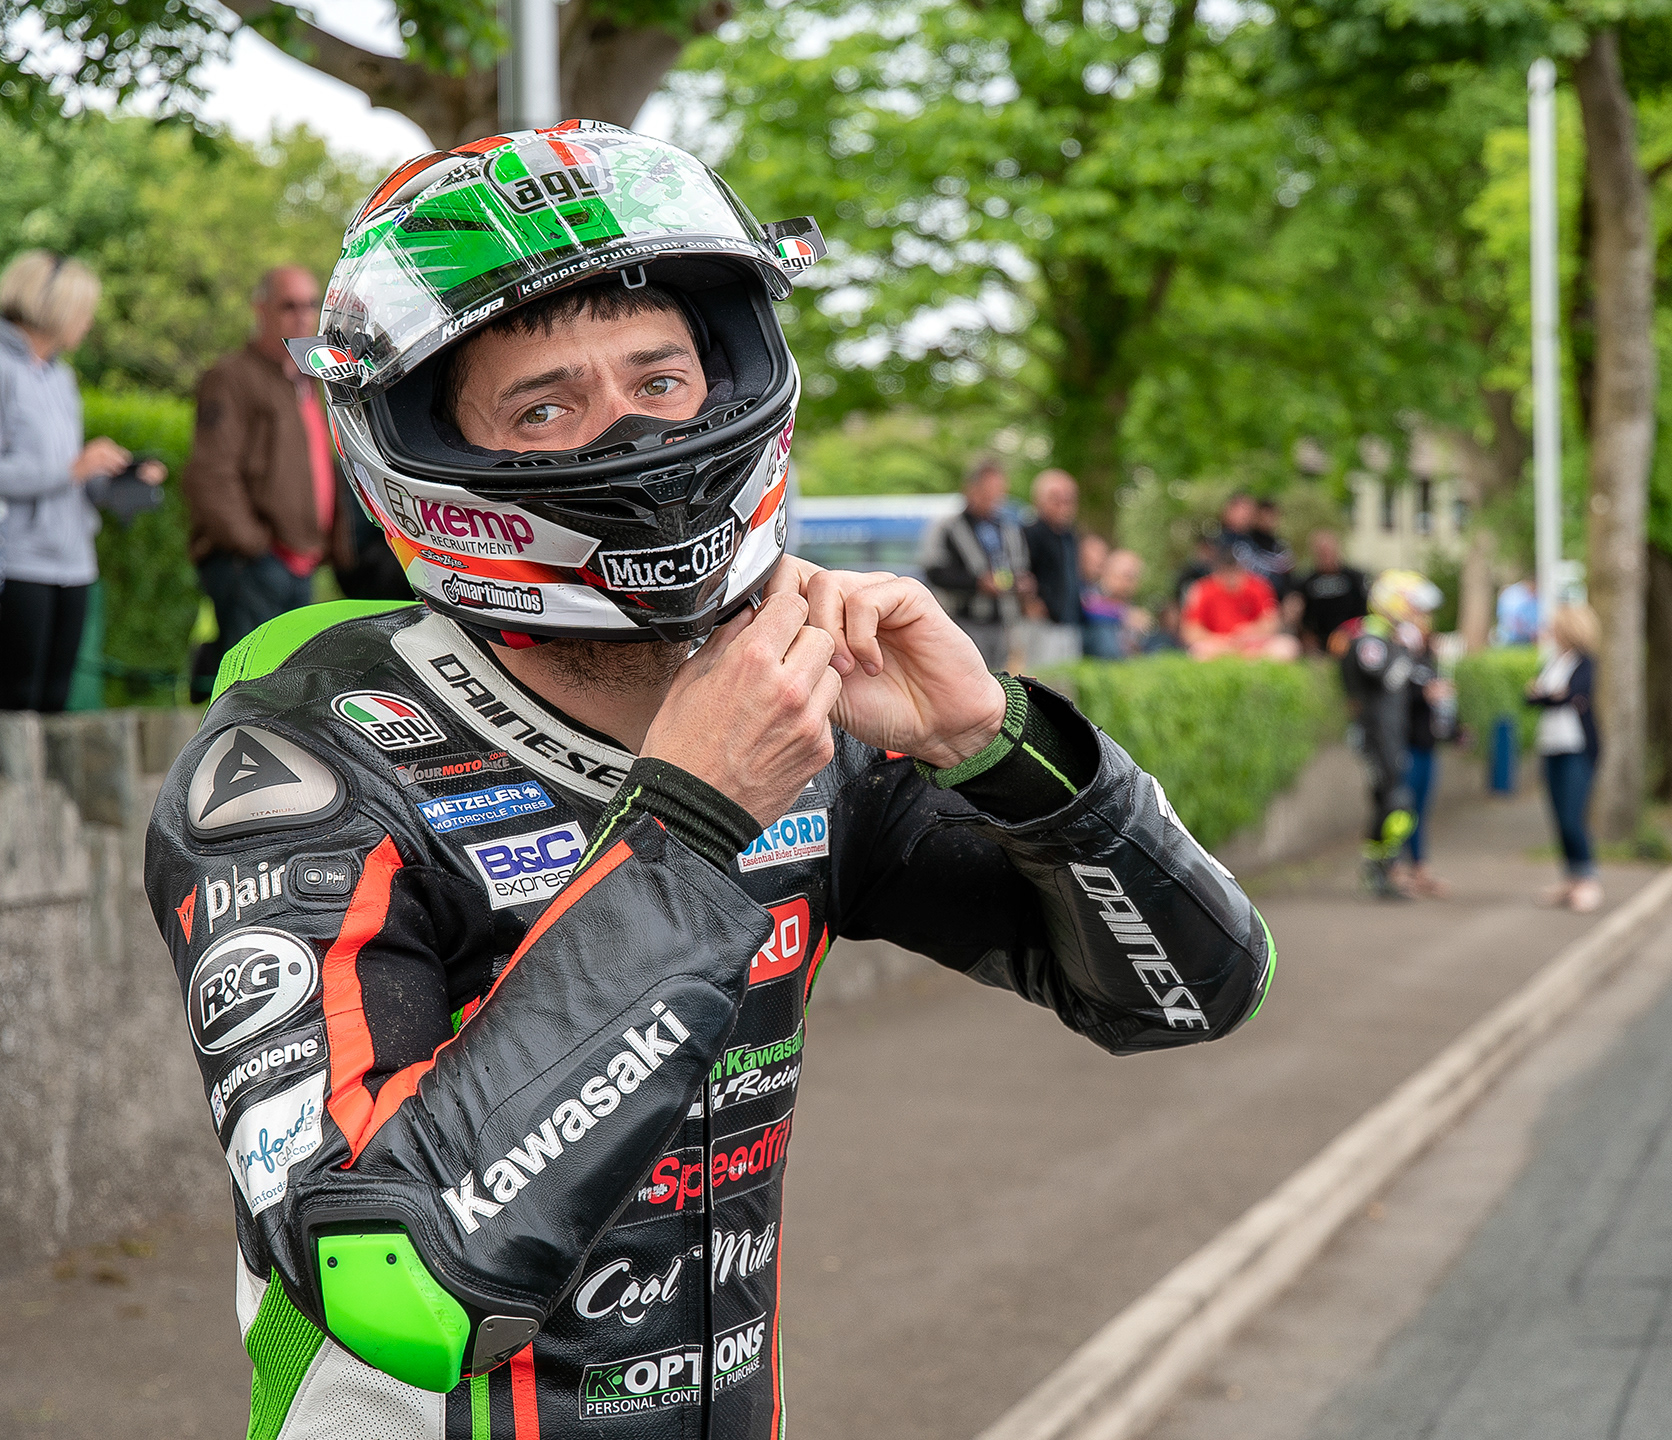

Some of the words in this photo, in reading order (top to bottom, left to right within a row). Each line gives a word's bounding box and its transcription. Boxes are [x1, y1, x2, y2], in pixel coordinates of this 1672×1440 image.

[441, 297, 505, 341] Kriega
[430, 534, 514, 555] RECRUITMENT
[607, 524, 733, 586] Muc-Off
[456, 580, 542, 612] martimotos
[427, 653, 630, 788] DAINESE
[250, 807, 297, 818] TITANIUM
[422, 787, 523, 819] METZELER
[432, 807, 508, 831] MOTORCYCLE
[510, 799, 548, 816] TYRES
[475, 830, 582, 880] B&C
[741, 852, 775, 867] Essential
[775, 849, 793, 860] Rider
[793, 843, 826, 858] Equipment
[1068, 862, 1210, 1030] DAINESE
[201, 953, 281, 1030] R&G
[221, 1038, 319, 1101] silkolene
[440, 999, 691, 1235] Kawasaki
[576, 1257, 682, 1320] Cool
[586, 1396, 656, 1415] PERSONAL
